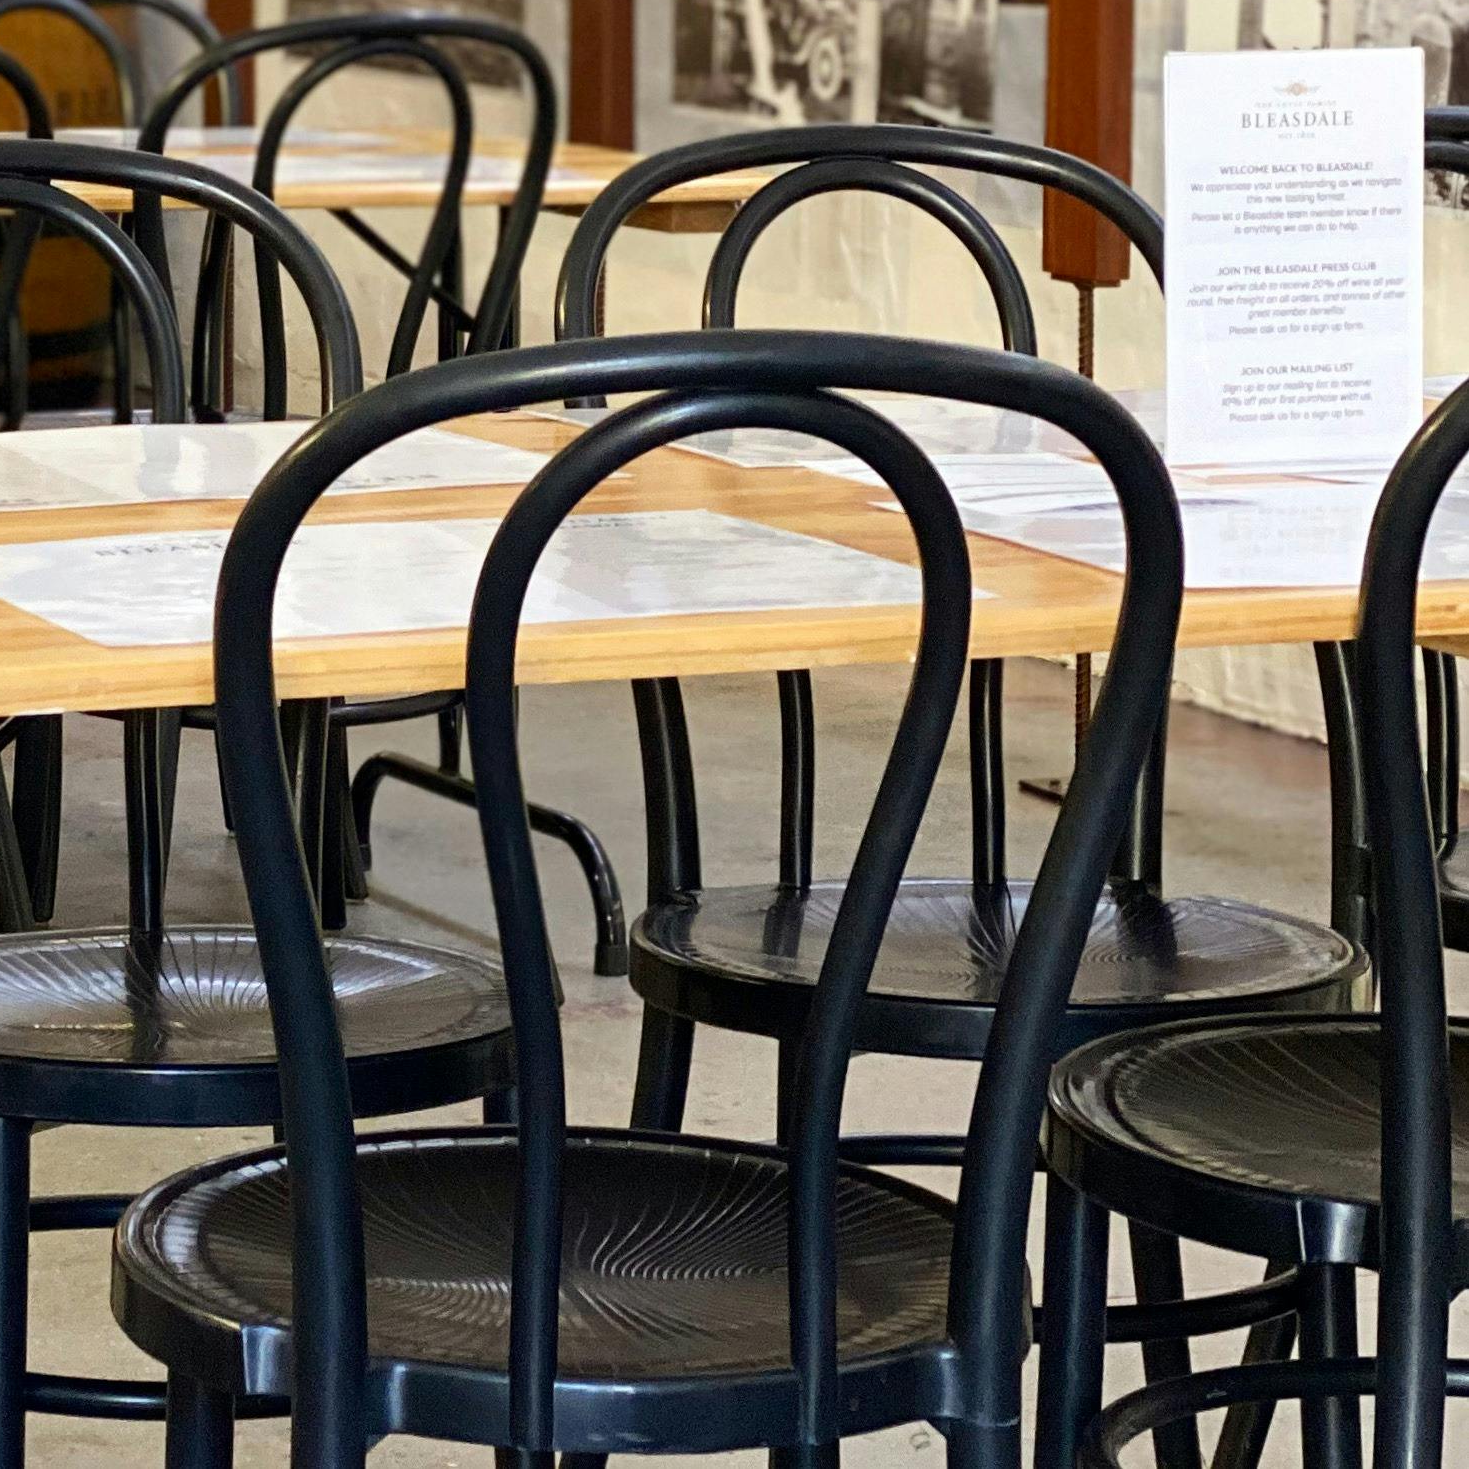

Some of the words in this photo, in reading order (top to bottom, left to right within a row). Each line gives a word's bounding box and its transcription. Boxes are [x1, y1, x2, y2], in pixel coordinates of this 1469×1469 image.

[1241, 111, 1354, 128] BLEASDALE
[1219, 164, 1270, 175] WELCOME
[1272, 164, 1298, 173] BACK
[1316, 162, 1373, 172] BLEASDALE!
[1206, 181, 1251, 193] appreciate
[1254, 183, 1272, 191] your
[1275, 179, 1337, 191] understanding
[1365, 177, 1402, 188] navigate
[1285, 193, 1314, 204] tasting
[1243, 210, 1284, 219] Bleasdale
[1287, 209, 1308, 218] team
[1310, 208, 1344, 217] member
[1346, 208, 1369, 216] know
[1380, 207, 1402, 215] there
[1243, 224, 1282, 235] anything
[1218, 266, 1241, 276] JOIN
[1243, 265, 1261, 274] THE
[1265, 264, 1318, 274] BLEASDALE
[1321, 263, 1350, 272] PRESS
[1352, 262, 1376, 271] CLUB
[1248, 282, 1267, 290] club
[1280, 281, 1310, 289] receive
[1217, 296, 1235, 305] free
[1236, 295, 1265, 306] freight
[1383, 291, 1405, 300] other
[1248, 308, 1270, 319] great
[1272, 307, 1307, 316] member
[1229, 325, 1258, 334] Please
[1311, 322, 1329, 334] sign
[1241, 366, 1265, 375] JOIN
[1266, 365, 1288, 374] OUR
[1291, 363, 1332, 373] MAILING
[1334, 363, 1354, 372] LIST
[1283, 381, 1314, 392] mailing
[1341, 379, 1372, 388] receive
[1259, 398, 1277, 407] your
[1298, 394, 1338, 405] purchase
[1340, 393, 1359, 402] with
[1229, 412, 1258, 421] Please
[1311, 410, 1330, 421] sign
